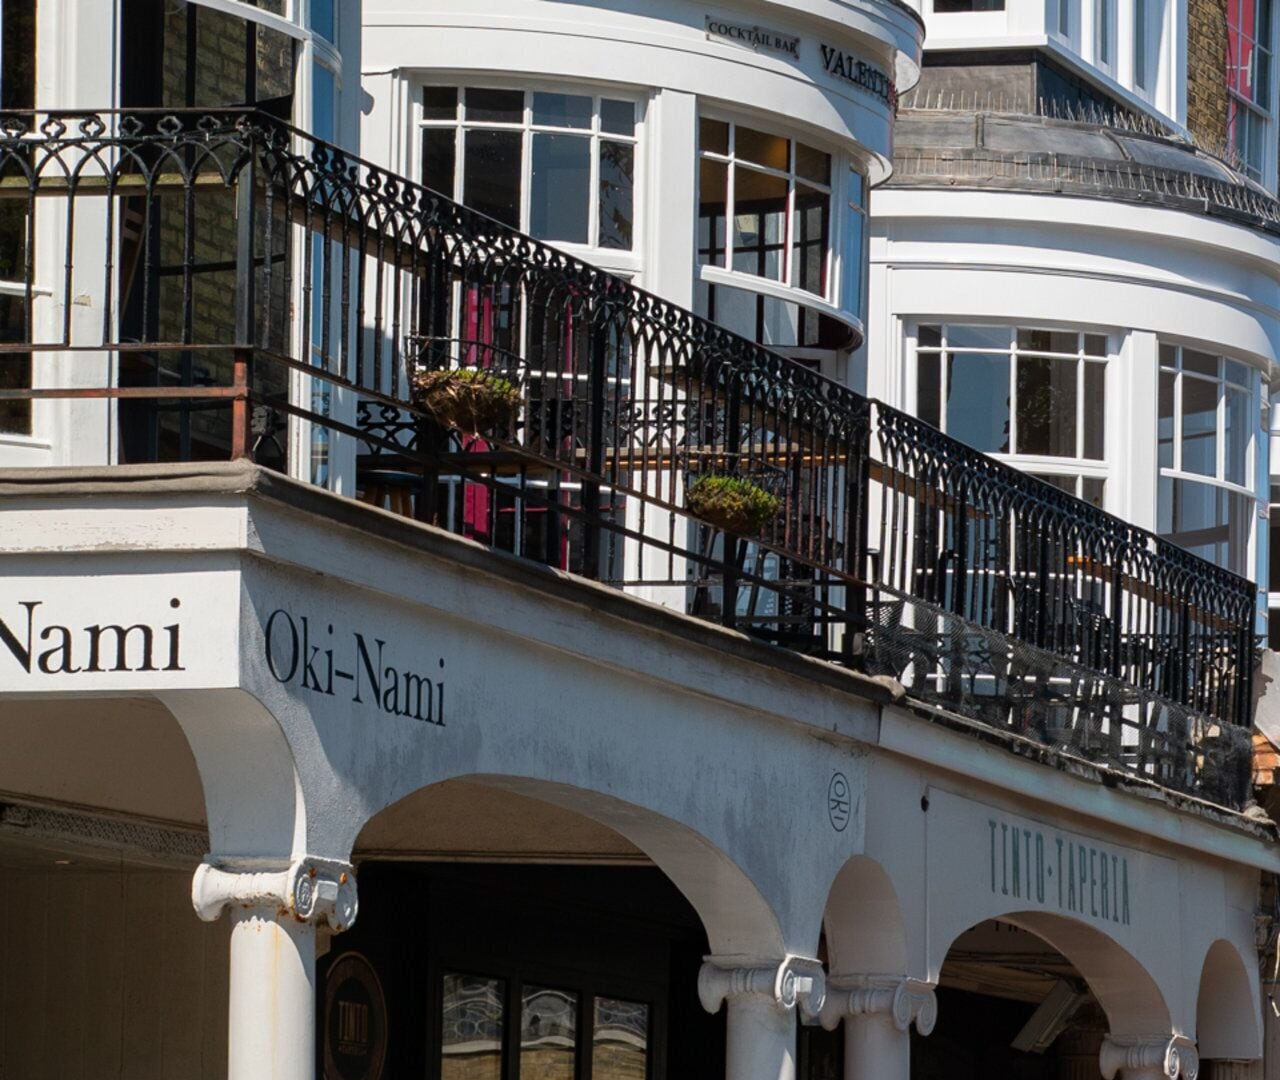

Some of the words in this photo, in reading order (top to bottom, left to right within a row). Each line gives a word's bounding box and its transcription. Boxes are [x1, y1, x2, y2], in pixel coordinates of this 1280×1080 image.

[708, 21, 772, 47] COCKTAIL
[774, 38, 798, 53] BAR
[265, 609, 447, 727] Oki-Nami
